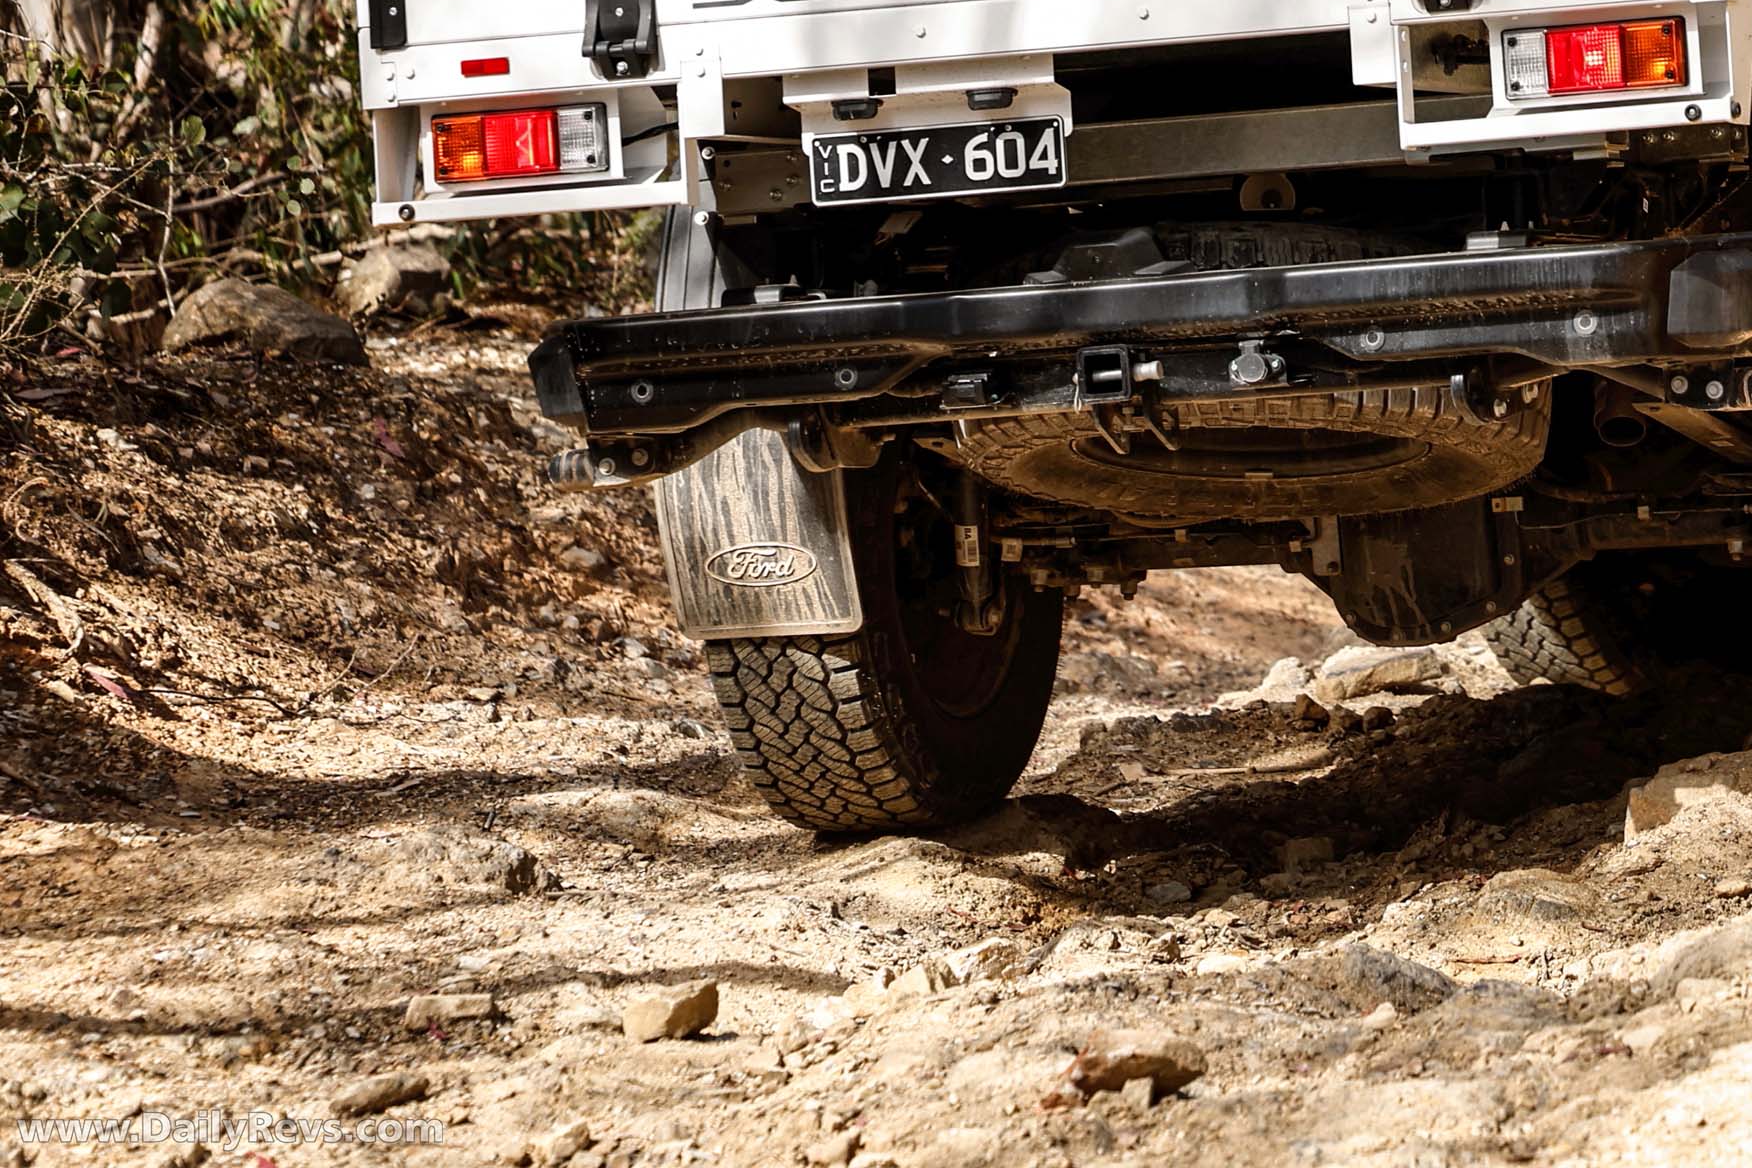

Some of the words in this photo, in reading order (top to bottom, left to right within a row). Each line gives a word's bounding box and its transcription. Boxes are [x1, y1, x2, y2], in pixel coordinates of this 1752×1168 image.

[818, 145, 835, 193] VIC
[836, 137, 932, 192] DVX
[963, 127, 1059, 181] 604
[727, 548, 795, 579] Ford
